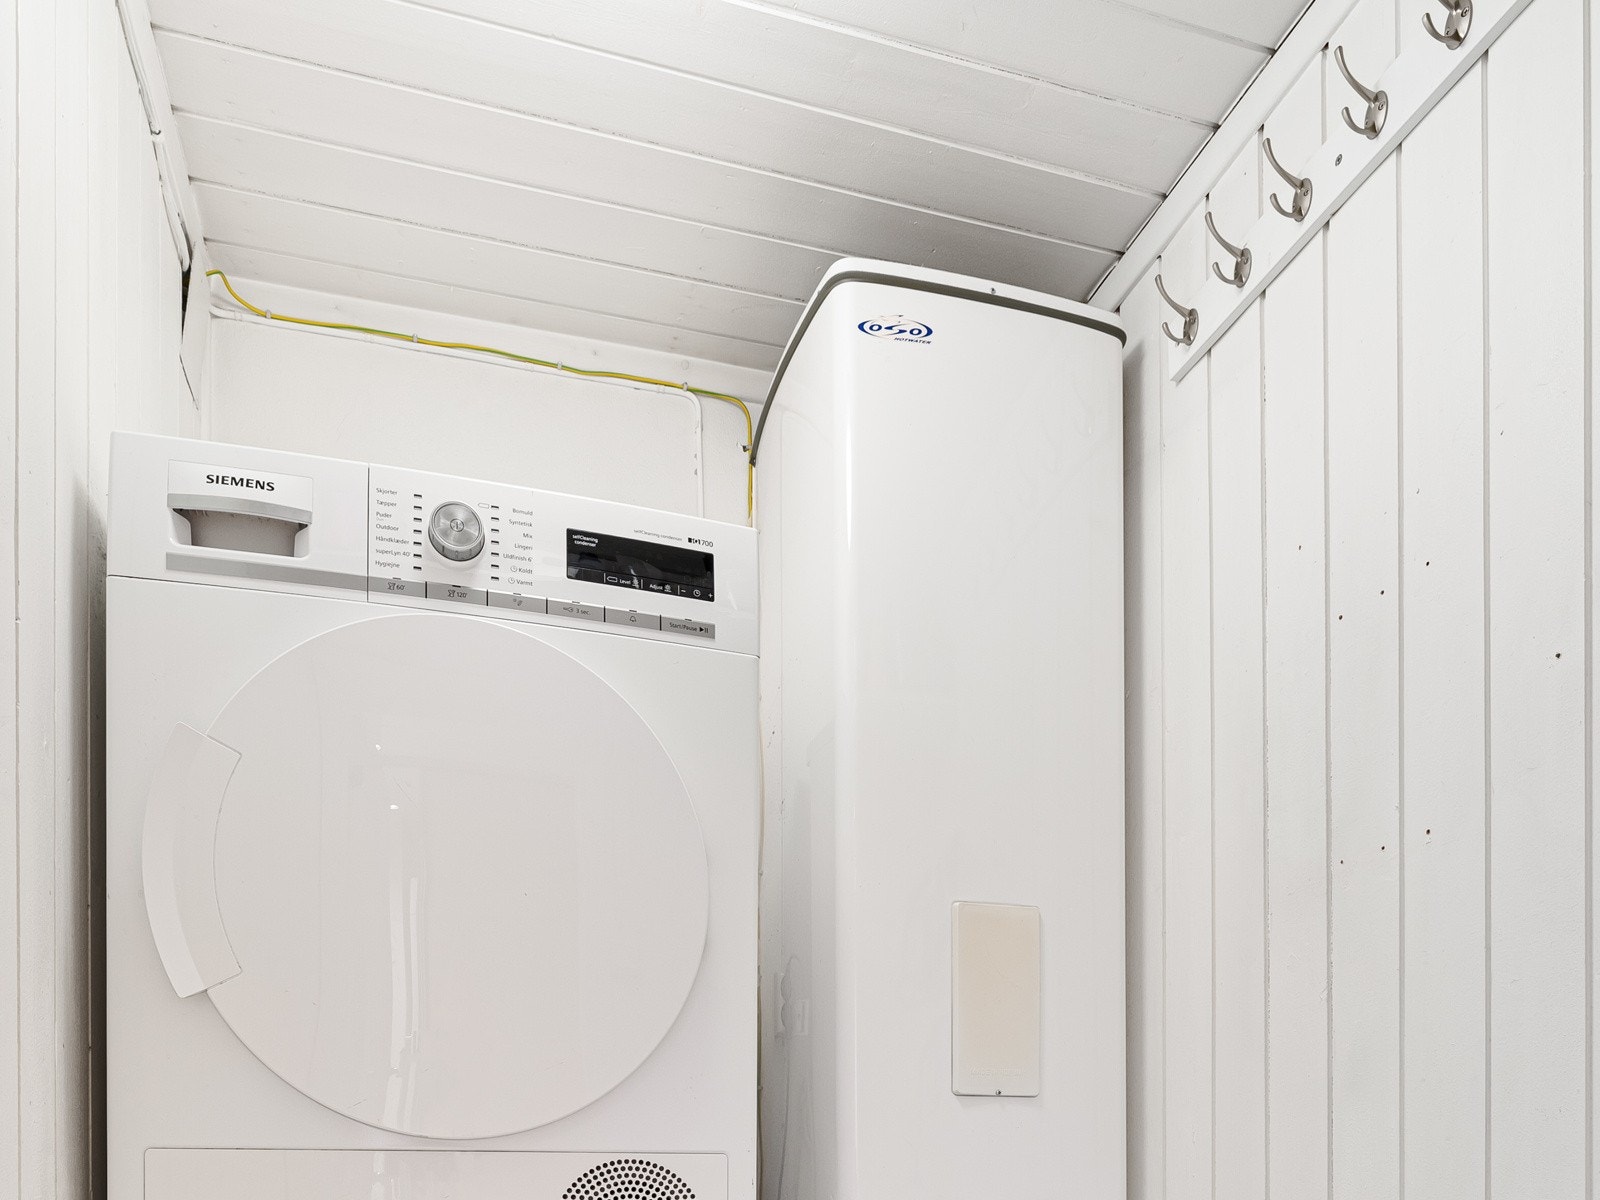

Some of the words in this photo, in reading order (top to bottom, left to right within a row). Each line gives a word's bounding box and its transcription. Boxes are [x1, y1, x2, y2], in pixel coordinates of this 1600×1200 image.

[206, 474, 275, 492] SIEMENS
[376, 487, 398, 495] Skjorter
[376, 499, 397, 507] Tæpper
[376, 511, 392, 519] Puder
[512, 507, 533, 516] Bomuld
[508, 518, 533, 527] Syntetisk
[375, 523, 399, 531] Outdoor
[375, 535, 410, 545] Håndklæder
[375, 560, 400, 569] Hygiejne
[516, 579, 534, 587] Varmt
[649, 583, 664, 591] Adjust
[576, 607, 581, 615] 3
[669, 622, 698, 632] Start/Pause
